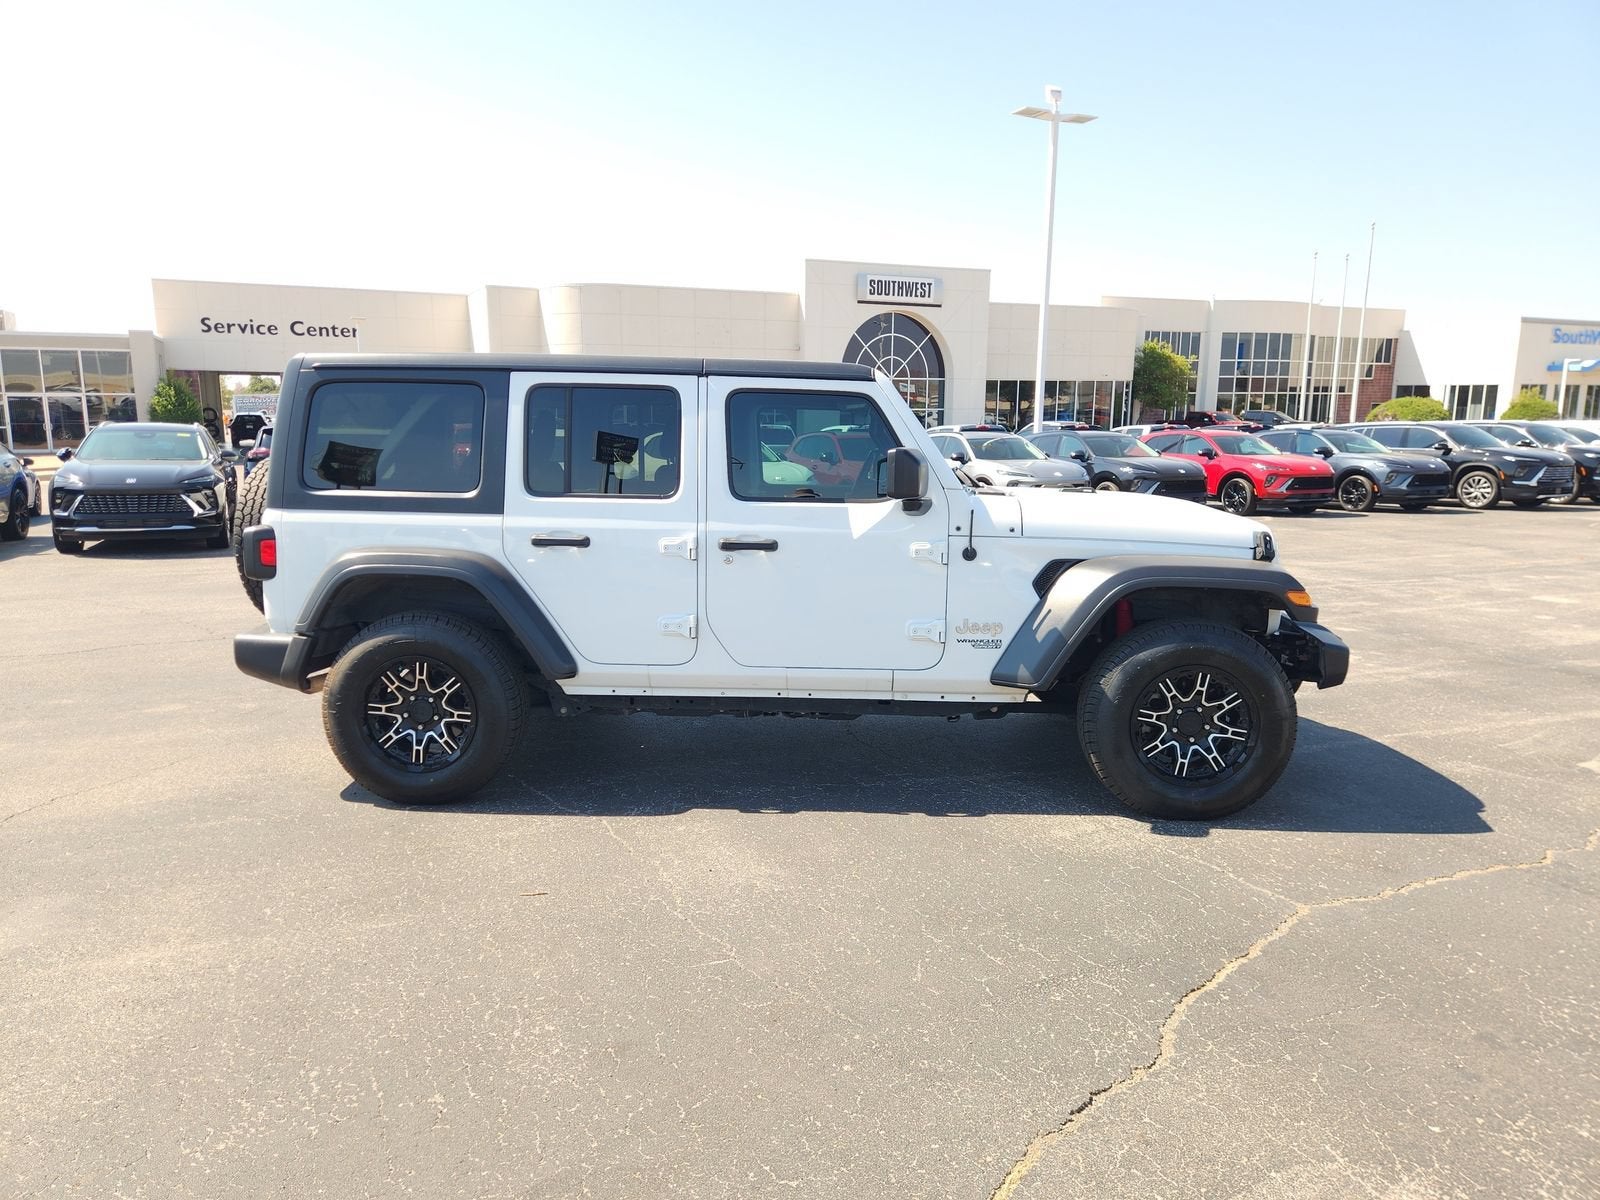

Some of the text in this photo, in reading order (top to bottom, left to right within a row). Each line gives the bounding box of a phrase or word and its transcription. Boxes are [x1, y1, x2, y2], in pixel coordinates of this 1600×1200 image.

[868, 278, 933, 298] SOUTHWEST
[200, 316, 357, 338] Service Center
[955, 617, 1003, 637] Jeep
